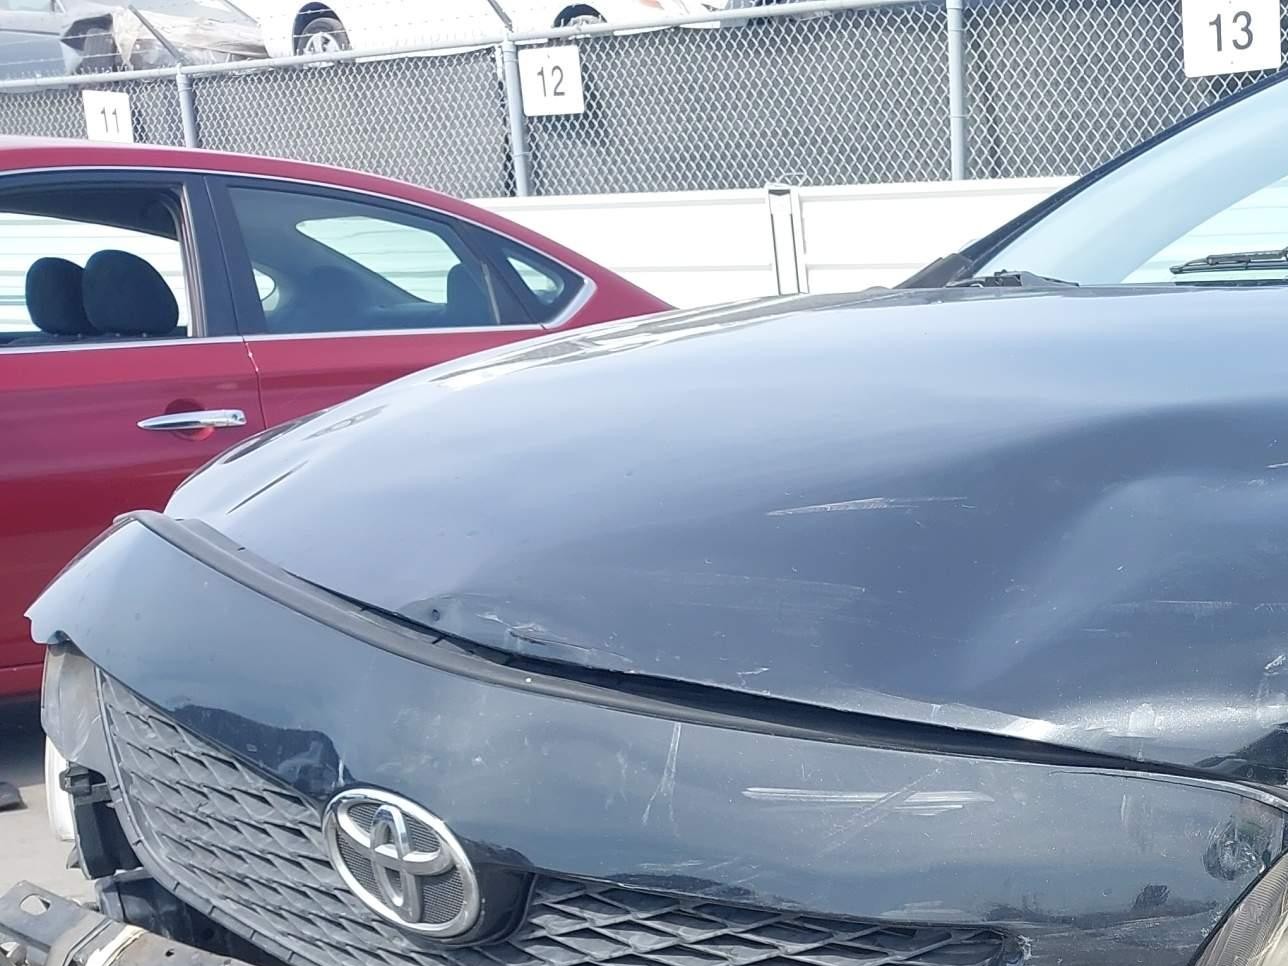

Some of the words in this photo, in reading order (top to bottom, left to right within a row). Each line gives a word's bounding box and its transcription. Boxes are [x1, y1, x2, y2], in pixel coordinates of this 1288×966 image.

[1208, 10, 1254, 52] 13
[536, 65, 566, 97] 12
[100, 106, 120, 134] 11
